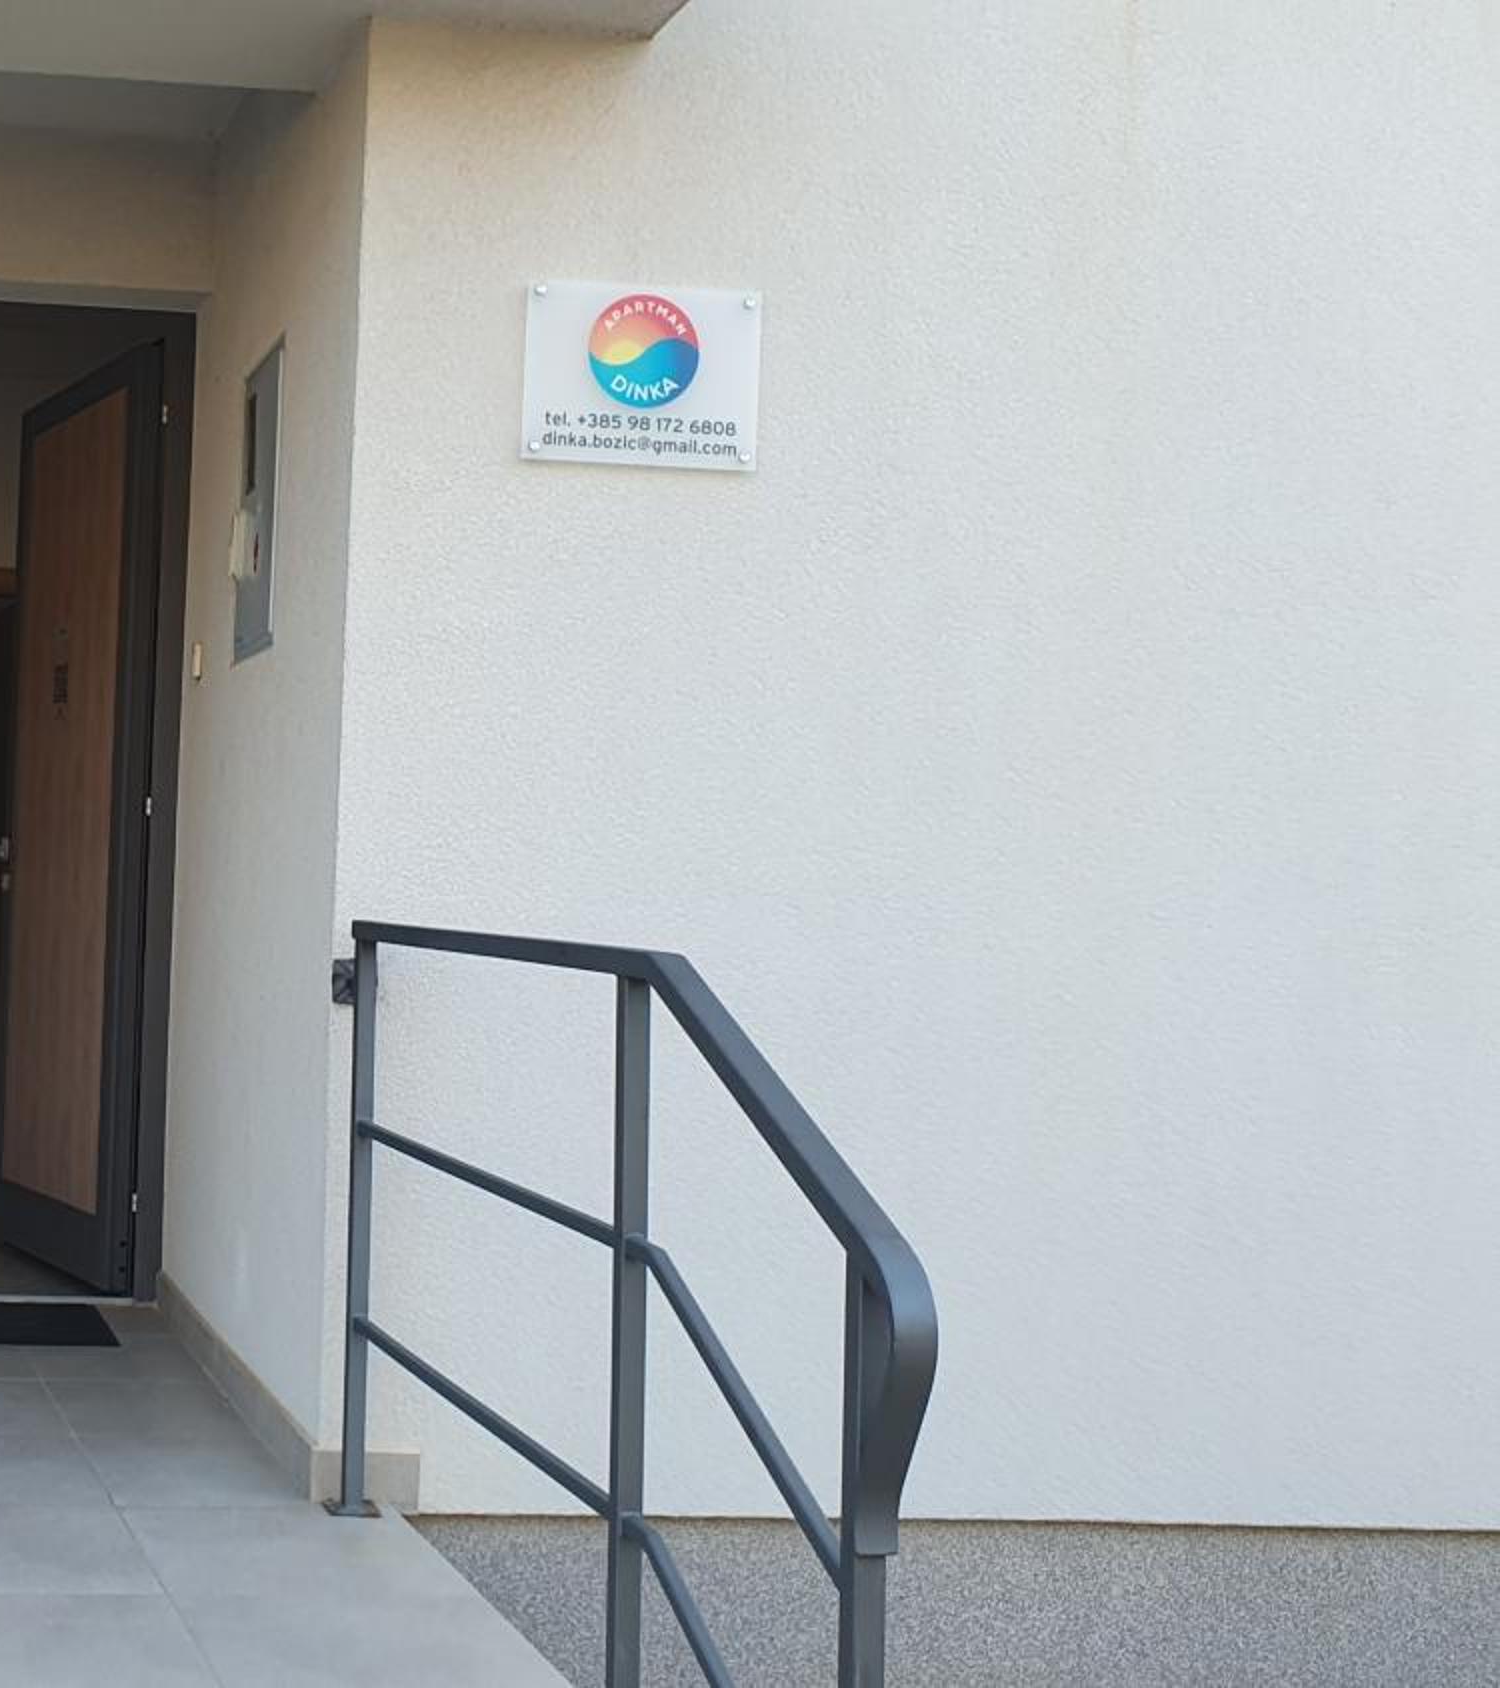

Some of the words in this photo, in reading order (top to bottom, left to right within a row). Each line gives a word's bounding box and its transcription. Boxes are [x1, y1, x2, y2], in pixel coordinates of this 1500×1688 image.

[604, 301, 687, 336] APARTMAN
[611, 374, 679, 401] DINKA
[545, 411, 571, 427] tel.
[577, 413, 622, 429] +385
[627, 416, 652, 430] 98
[656, 418, 683, 434] 172
[689, 421, 737, 437] 6808
[542, 432, 737, 457] dinka.bozic@gmail.com
